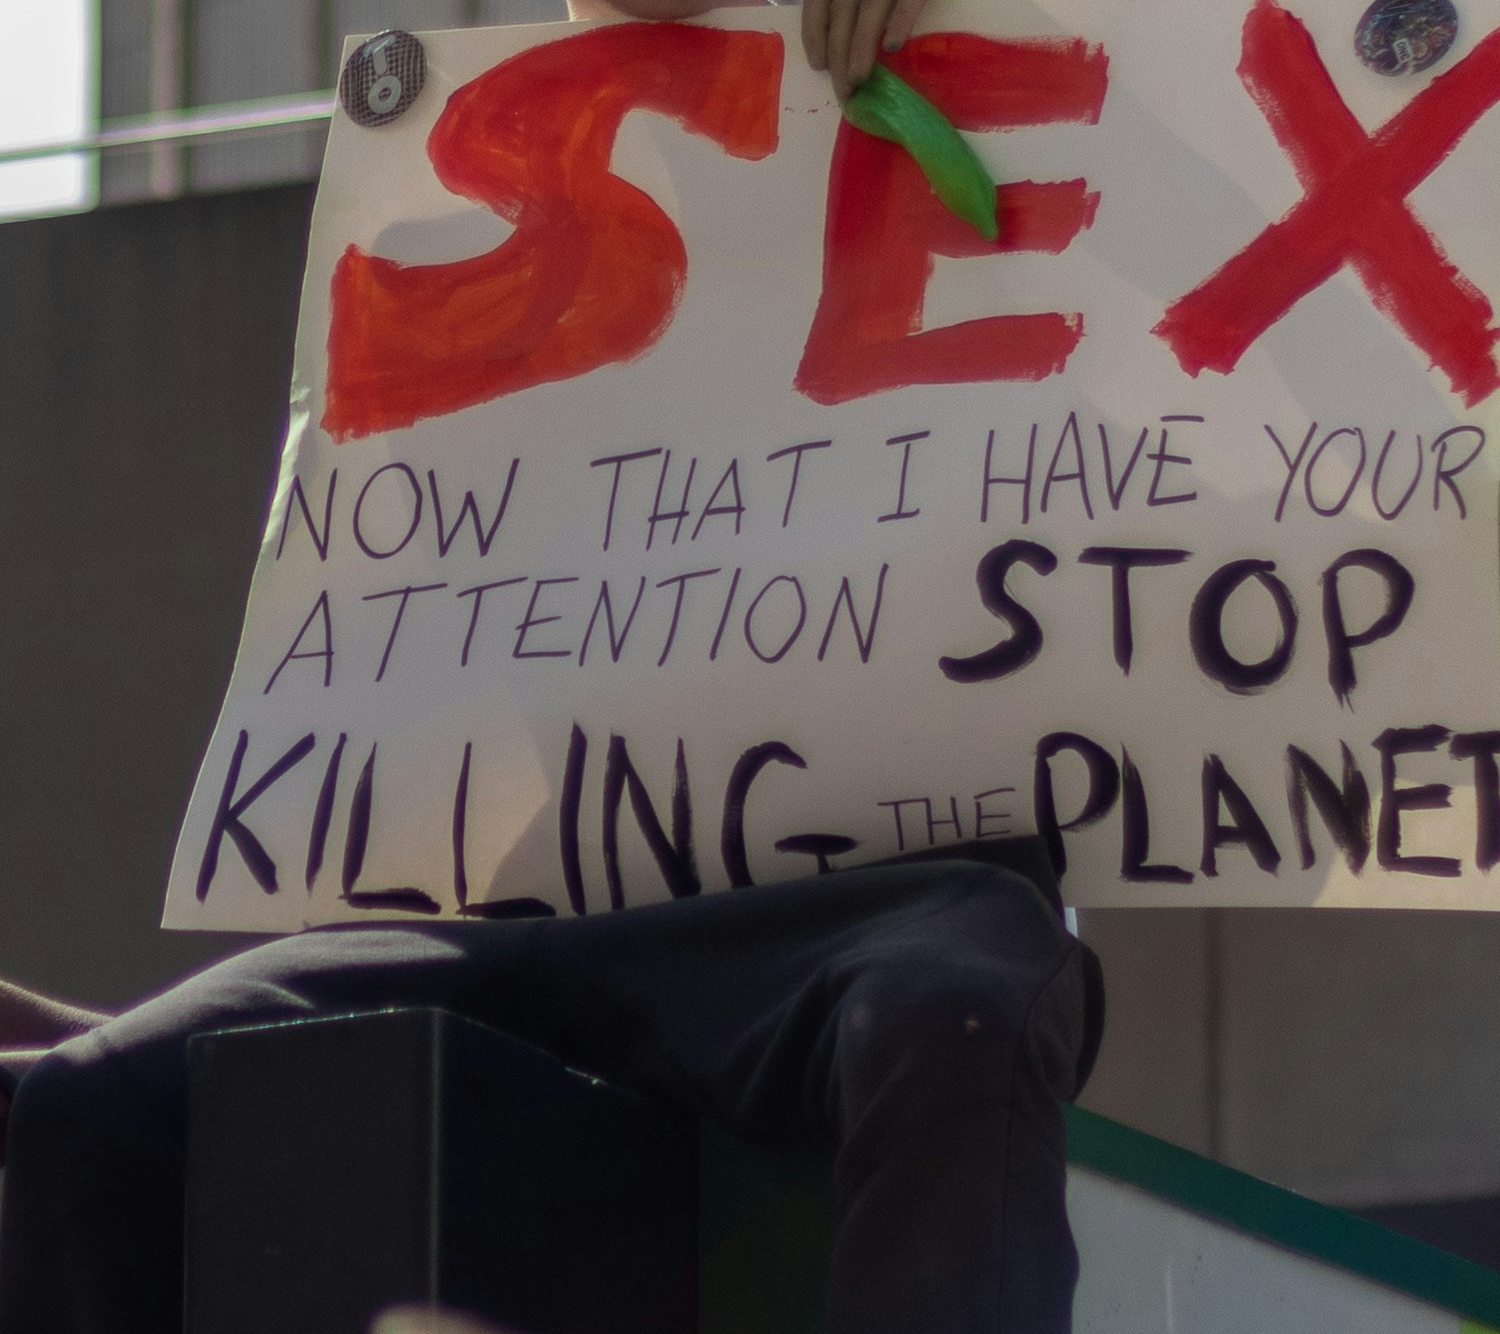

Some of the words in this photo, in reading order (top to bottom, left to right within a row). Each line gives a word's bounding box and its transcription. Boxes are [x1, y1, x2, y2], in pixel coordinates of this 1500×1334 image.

[273, 457, 519, 560] NOW
[590, 440, 834, 551] THAT
[876, 430, 931, 524] I
[980, 412, 1206, 526] HAVE
[1264, 423, 1486, 522] YOUR
[265, 563, 890, 694] ATTENTION
[939, 539, 1415, 709] STOP
[196, 721, 860, 921] KILLING
[877, 787, 1016, 851] THE
